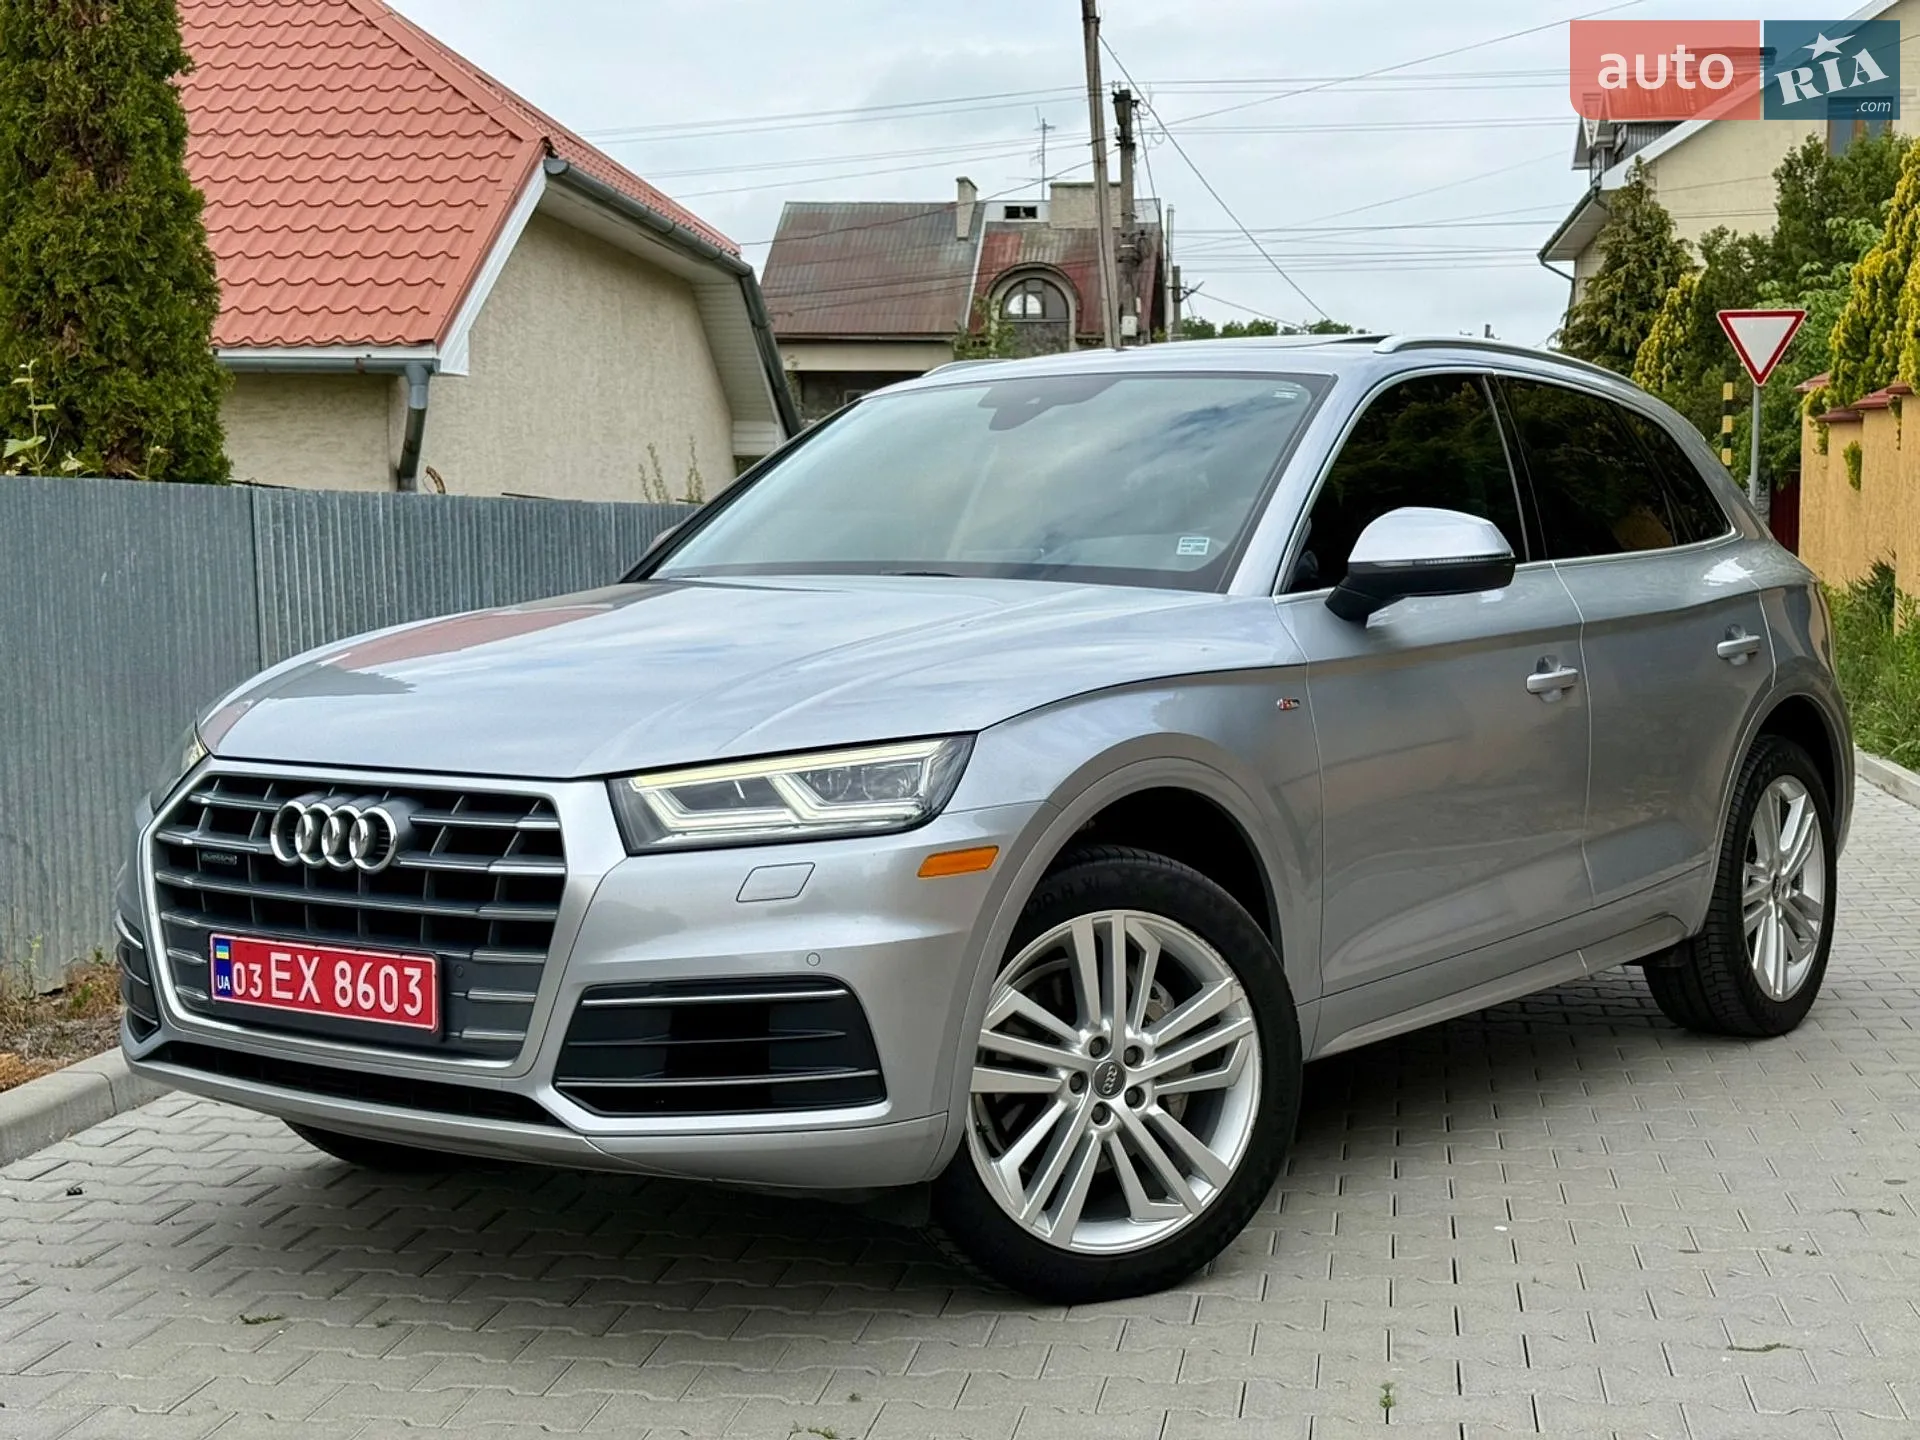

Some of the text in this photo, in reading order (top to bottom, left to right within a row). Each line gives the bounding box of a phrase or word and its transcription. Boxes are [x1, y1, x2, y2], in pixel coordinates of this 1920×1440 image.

[217, 974, 230, 991] UA
[232, 951, 423, 1016] 03 EX 8603
